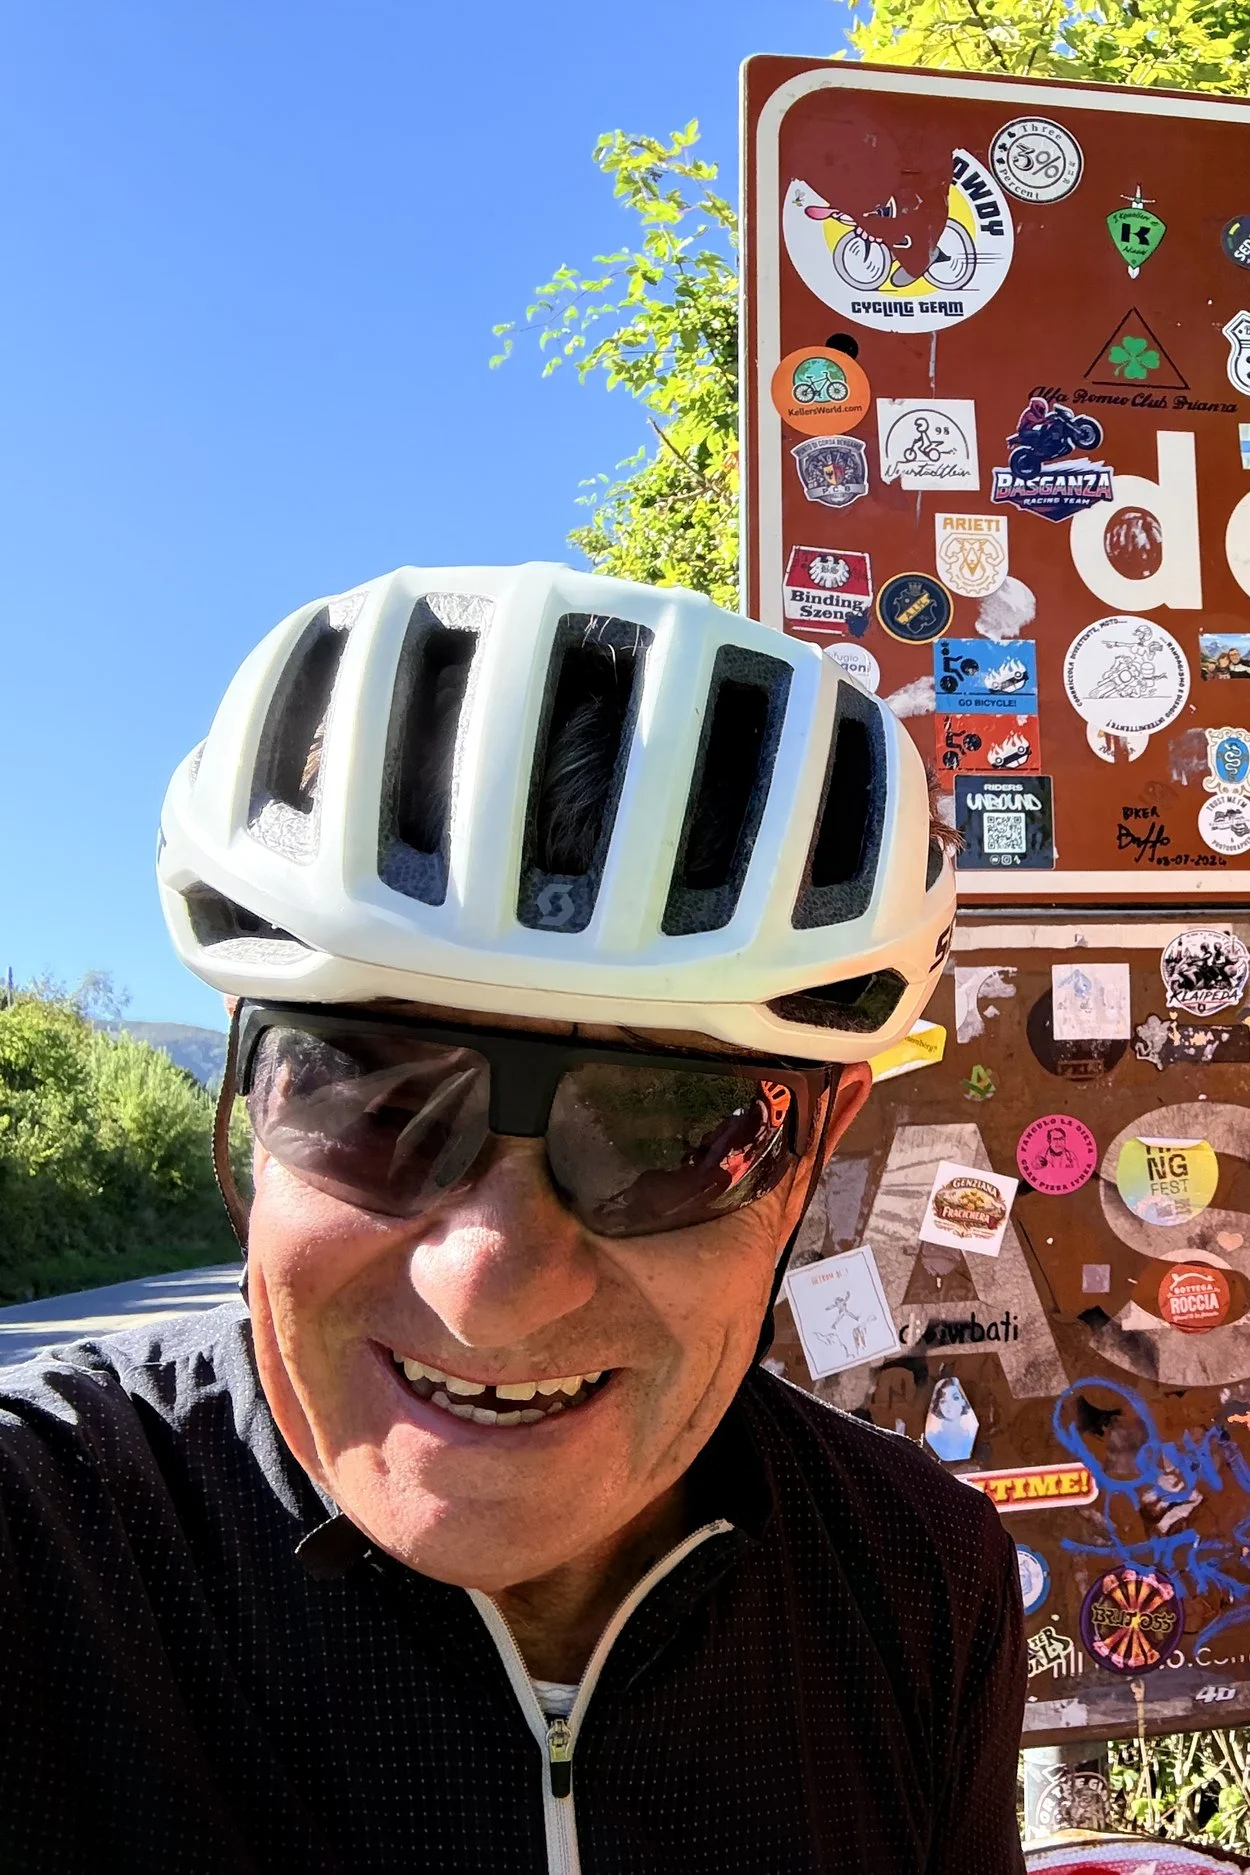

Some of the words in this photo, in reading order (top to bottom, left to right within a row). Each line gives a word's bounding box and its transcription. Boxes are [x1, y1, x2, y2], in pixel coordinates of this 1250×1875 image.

[1021, 123, 1063, 141] Three
[1012, 143, 1061, 179] 3%
[1000, 168, 1041, 200] Percent
[1131, 392, 1167, 409] Club
[788, 404, 862, 417] KellersWorld.com
[997, 472, 1112, 498] BASGANZA
[1023, 497, 1061, 506] RACING
[1064, 498, 1090, 506] TEAM
[943, 517, 1001, 533] ARIETI
[791, 590, 864, 612] Binding
[958, 698, 974, 708] GO
[975, 698, 1017, 708] BICYCLE!
[983, 783, 1023, 792] RIDERS
[966, 793, 1042, 811] UNBOUND
[1206, 797, 1226, 812] TRUST
[1226, 797, 1237, 805] ME
[1168, 989, 1241, 1003] KLAIPEDA
[1148, 1155, 1189, 1181] NG
[952, 1177, 998, 1198] GENZIANA
[1150, 1178, 1188, 1196] FEST
[1173, 1283, 1213, 1295] BOTTEGA
[1169, 1292, 1220, 1315] ROCCIA
